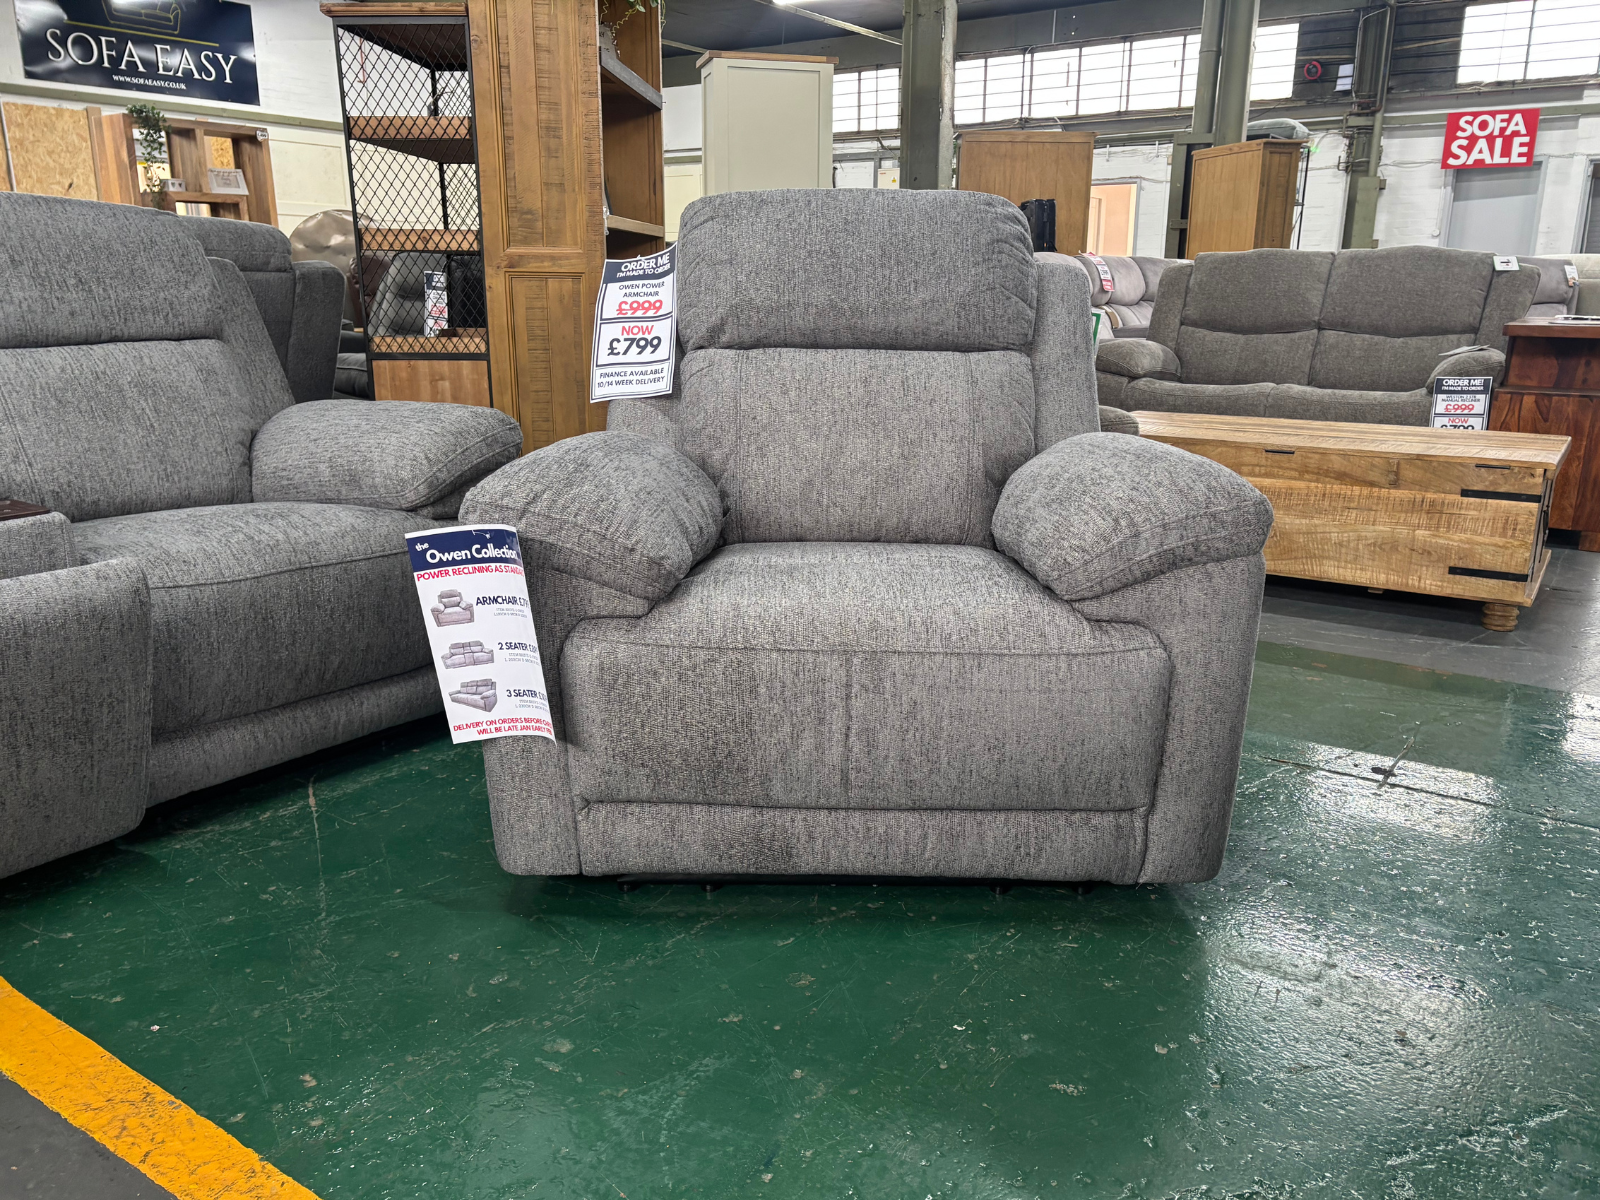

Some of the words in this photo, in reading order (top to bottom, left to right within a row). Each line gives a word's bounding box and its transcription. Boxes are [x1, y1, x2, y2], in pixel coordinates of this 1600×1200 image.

[46, 28, 147, 73] SOFA
[154, 43, 239, 84] EASY
[112, 74, 187, 90] WWW.SOFAEASY.CO.UK
[1456, 113, 1527, 137] SOFA
[1447, 136, 1530, 166] SALE
[621, 258, 657, 272] ORDER
[654, 262, 671, 274] ORDER
[618, 283, 641, 291] OWEN
[641, 280, 666, 289] POWER
[622, 290, 660, 298] ARMCHAIR
[616, 299, 664, 316] £999
[621, 325, 655, 336] NOW
[607, 335, 662, 356] £799
[599, 371, 628, 379] FINANCE
[628, 367, 665, 377] AVAILABLE
[635, 375, 666, 386] DELIVERY
[1444, 404, 1475, 413] £999
[415, 542, 429, 551] the
[426, 549, 471, 563] Owen
[471, 543, 519, 559] Collection
[416, 570, 451, 582] POWER
[452, 565, 494, 576] RECLINING
[494, 565, 504, 573] AS
[475, 595, 519, 606] ARMCHAIR
[498, 642, 504, 651] 2
[505, 642, 529, 651] SEATER
[506, 689, 512, 698] 3
[513, 689, 538, 699] SEATER
[453, 721, 484, 731] DELIVERY
[497, 717, 524, 725] ORDERS
[523, 717, 543, 725] BEFORE
[477, 728, 494, 736] WILL
